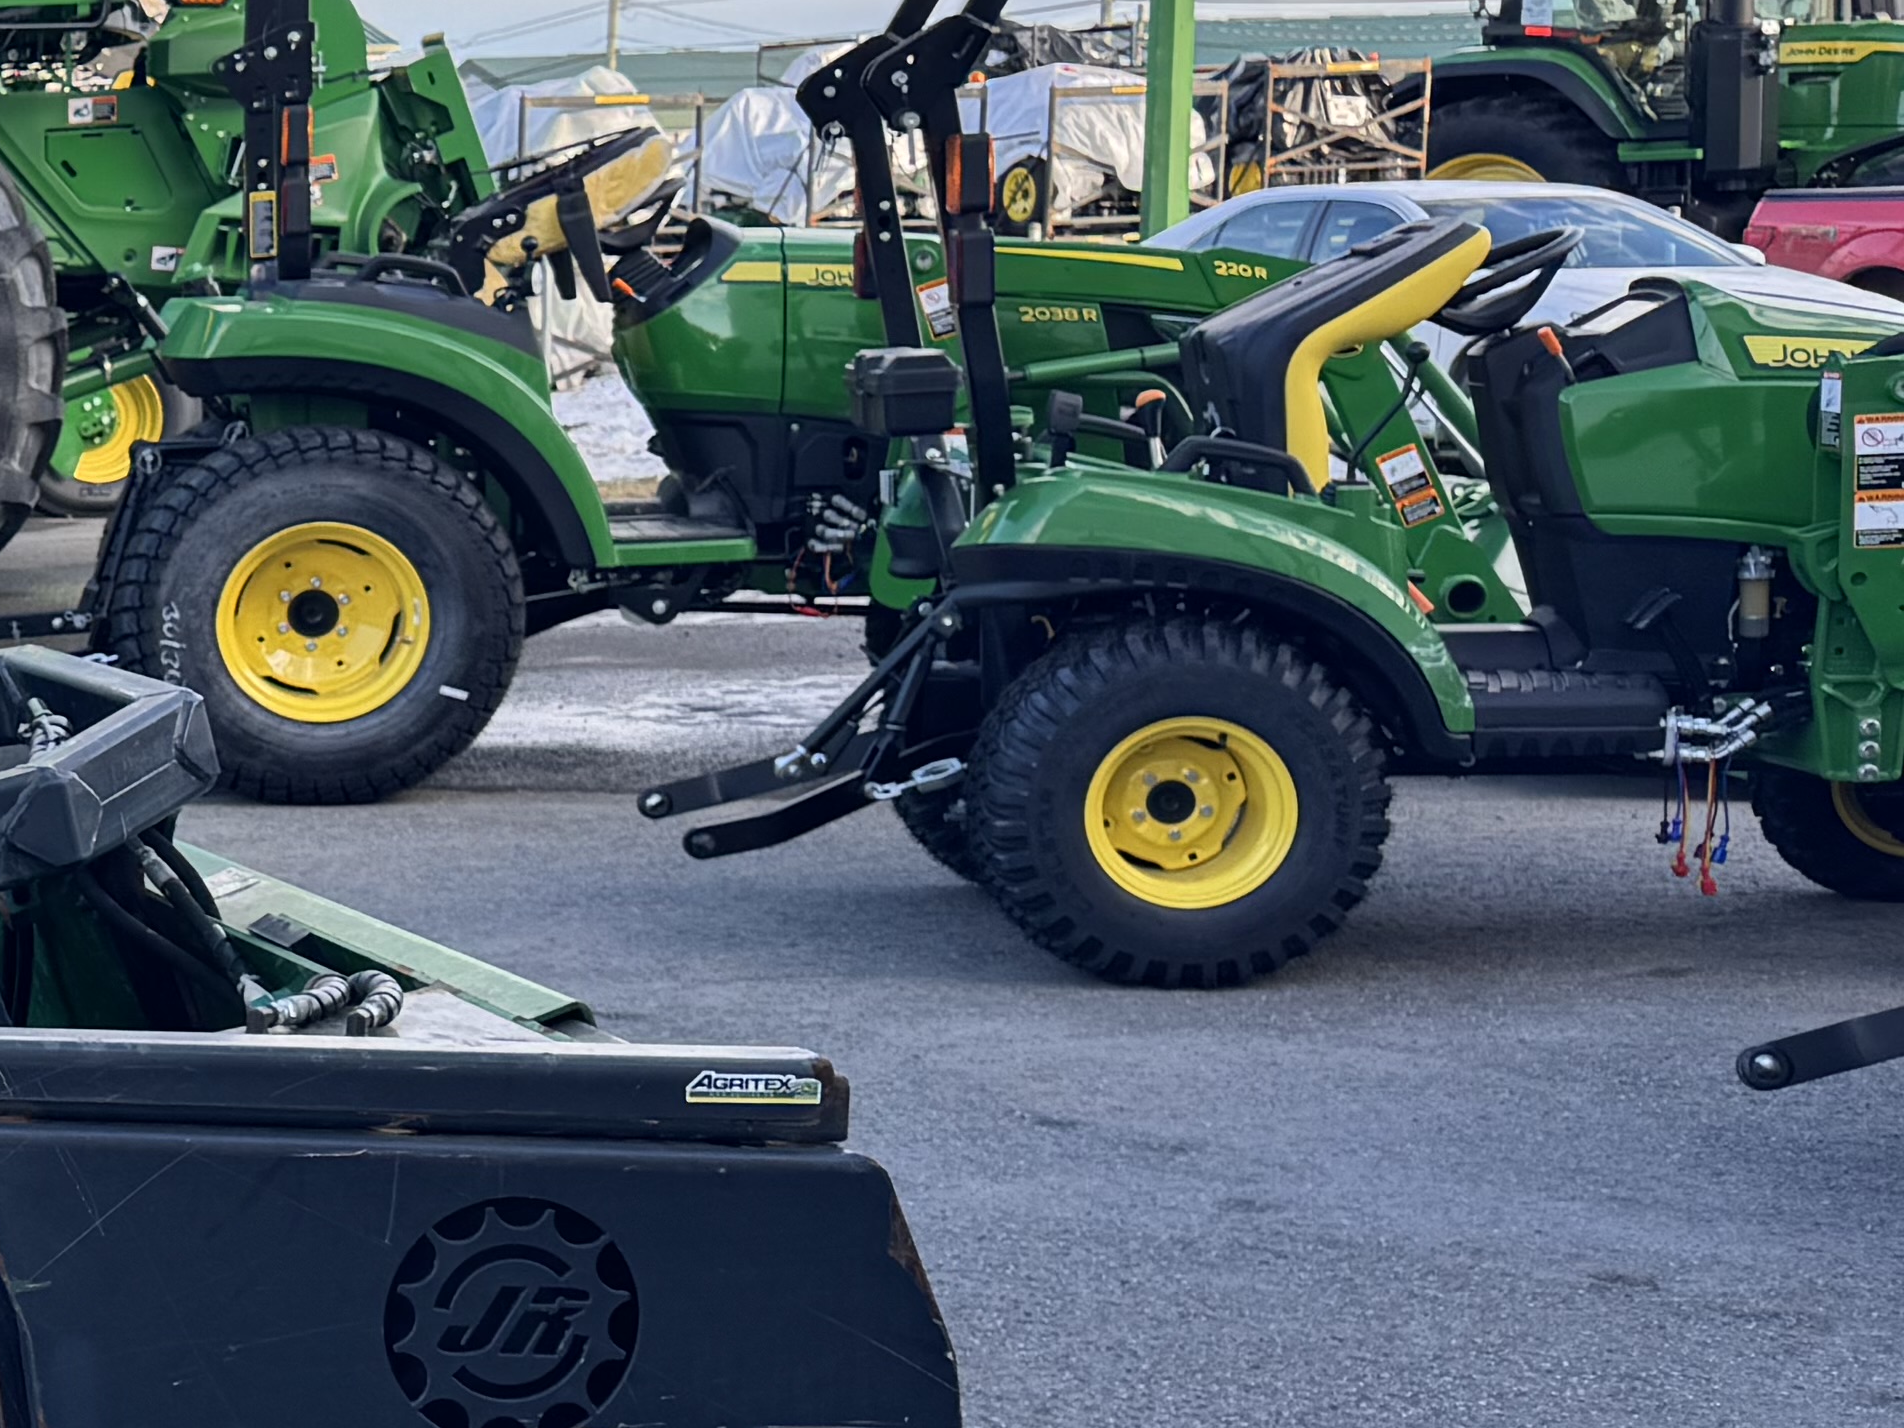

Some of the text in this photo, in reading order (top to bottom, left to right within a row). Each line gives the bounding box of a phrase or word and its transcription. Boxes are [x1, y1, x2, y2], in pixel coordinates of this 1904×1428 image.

[808, 267, 854, 285] JOH
[691, 1074, 793, 1091] AGRITEX
[438, 1283, 591, 1358] JR
